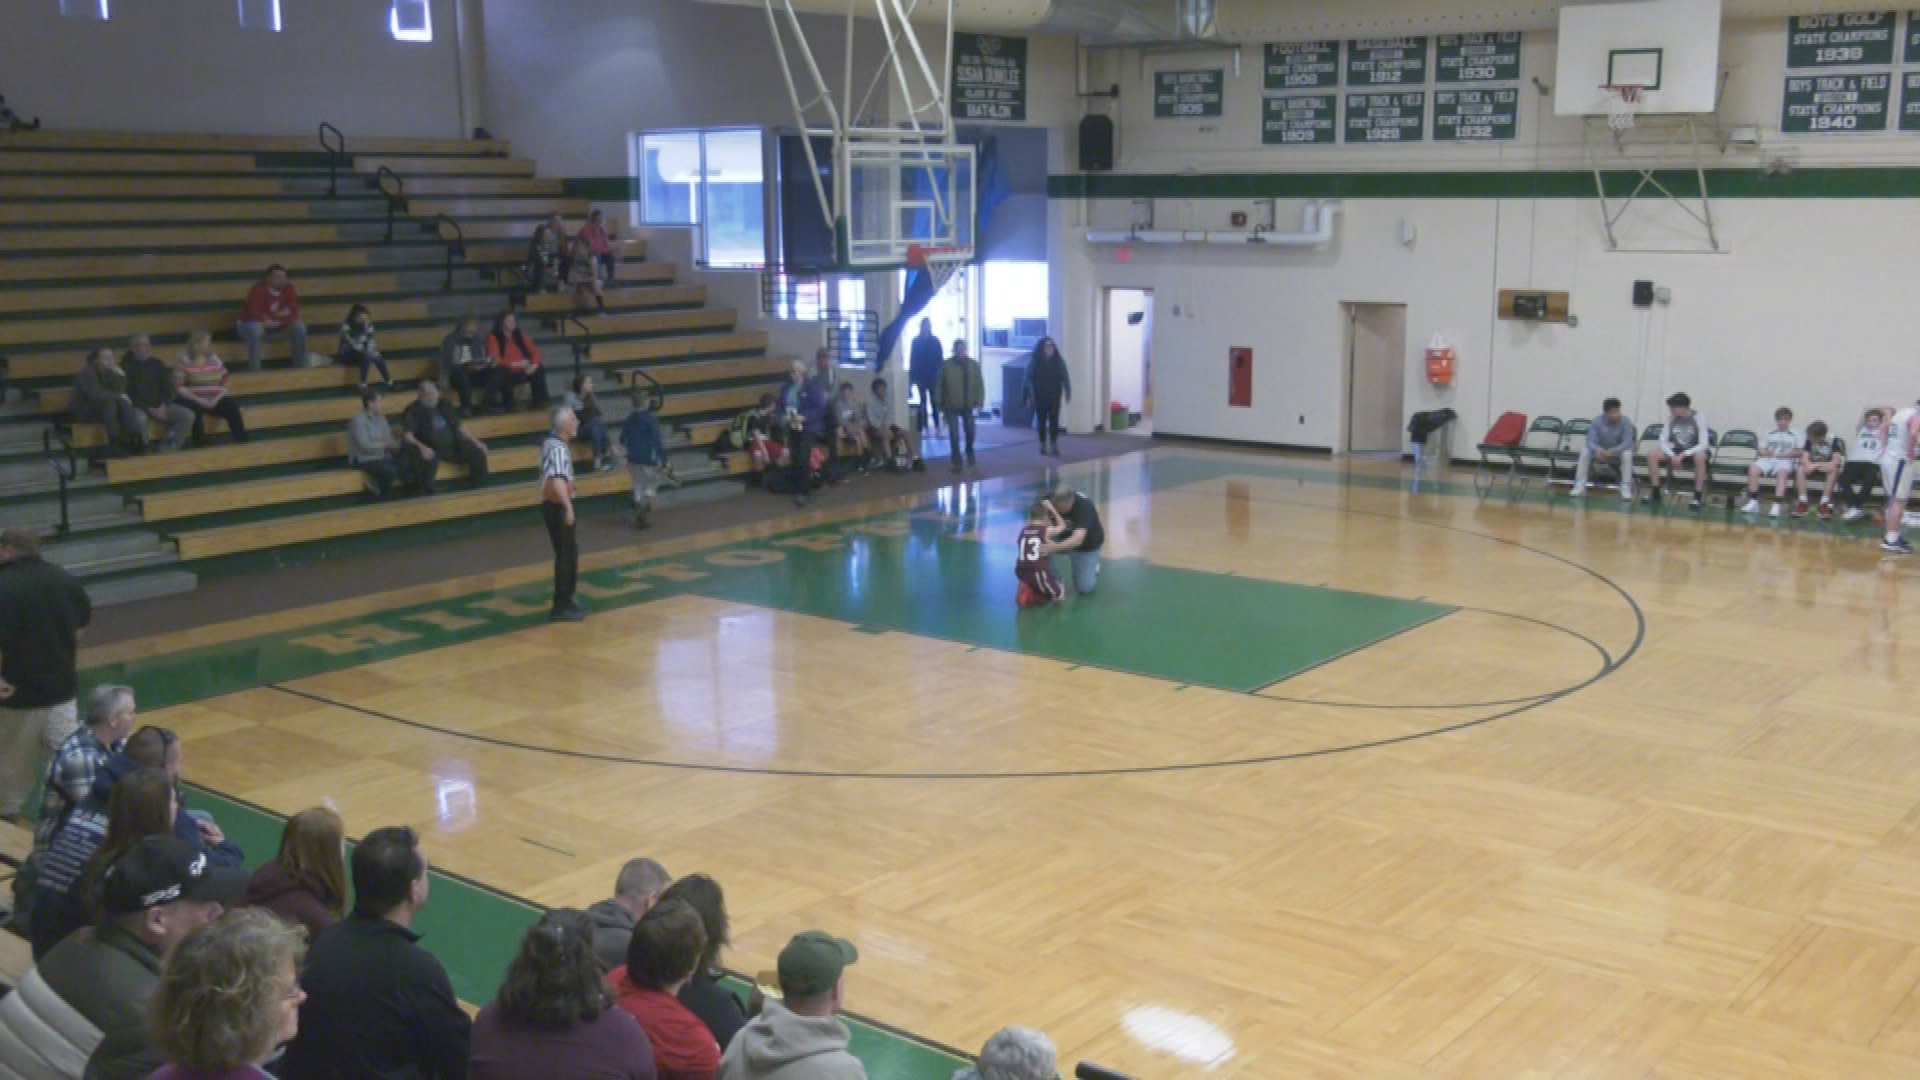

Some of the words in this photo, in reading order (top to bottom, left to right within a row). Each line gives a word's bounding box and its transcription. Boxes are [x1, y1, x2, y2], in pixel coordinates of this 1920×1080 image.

[1843, 12, 1884, 25] GOLF
[1793, 33, 1826, 45] STATE
[1829, 29, 1888, 42] CHAMPIONS
[1816, 77, 1844, 91] TRACK
[1860, 75, 1887, 89] FIELD
[1788, 105, 1819, 117] STATE
[1822, 102, 1882, 115] CHAMPIONS
[1810, 115, 1857, 129] 1940
[1020, 537, 1041, 561] 13
